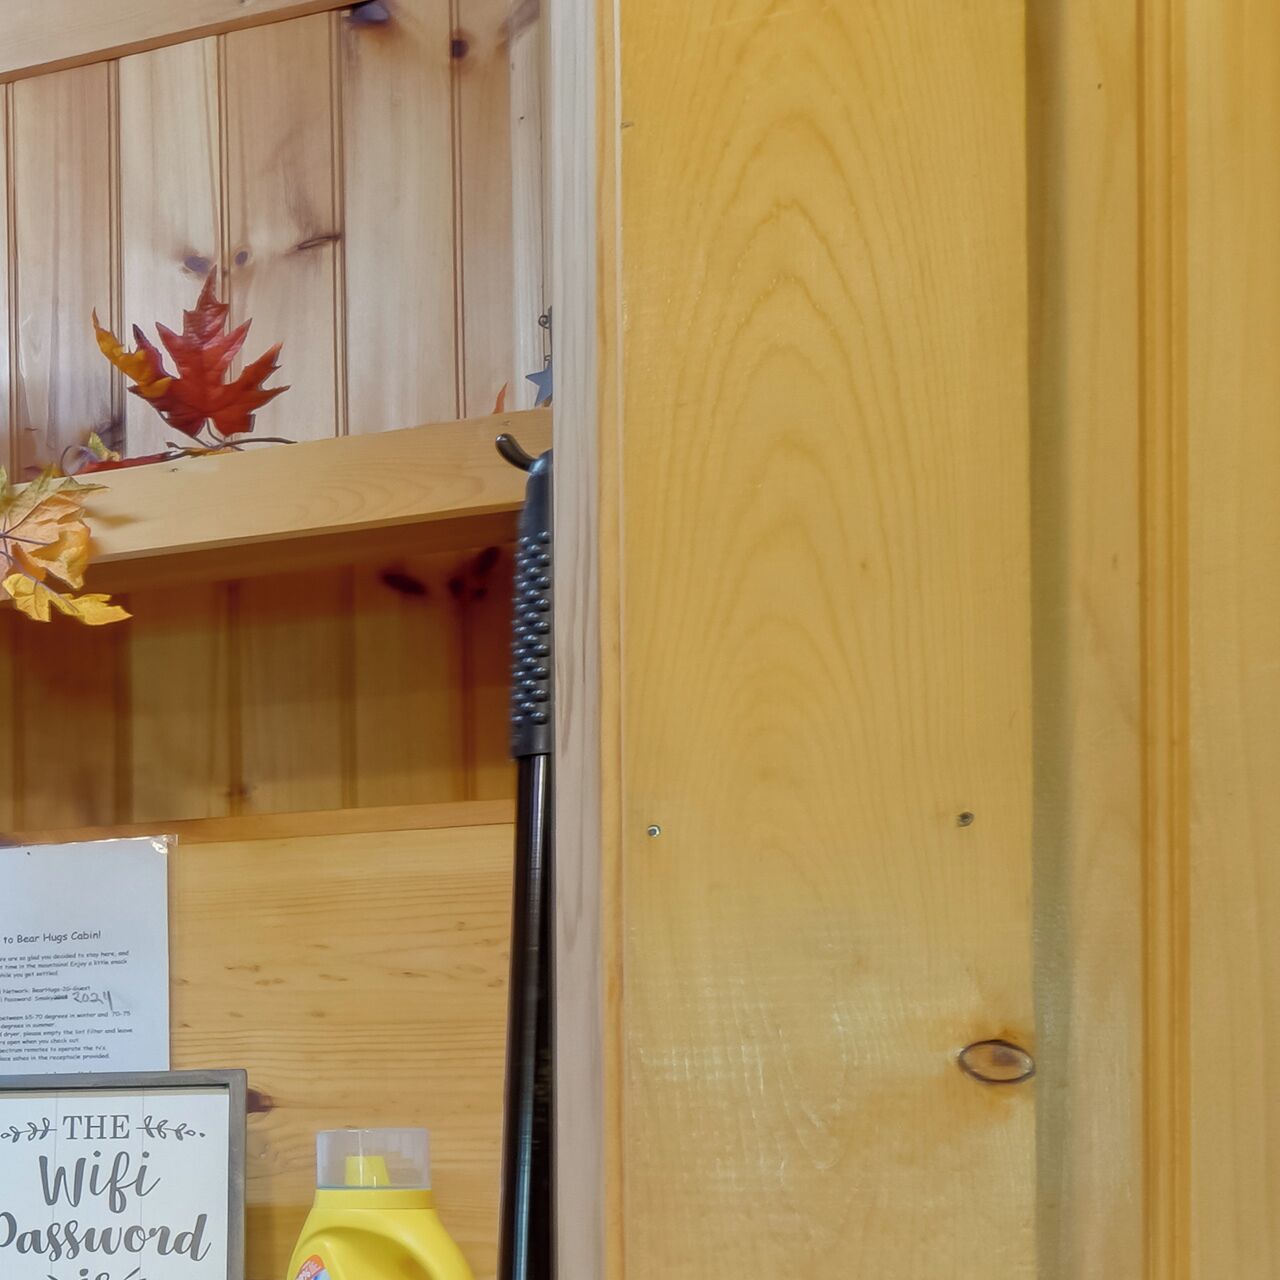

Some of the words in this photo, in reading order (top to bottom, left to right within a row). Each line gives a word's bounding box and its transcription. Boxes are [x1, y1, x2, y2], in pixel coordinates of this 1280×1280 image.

[4, 936, 13, 944] to
[17, 934, 40, 944] Bear
[43, 932, 68, 944] Hugs
[71, 930, 101, 940] Cabin!
[72, 991, 112, 1010] 2024
[62, 1114, 130, 1140] THE
[39, 1151, 161, 1213] Wifi
